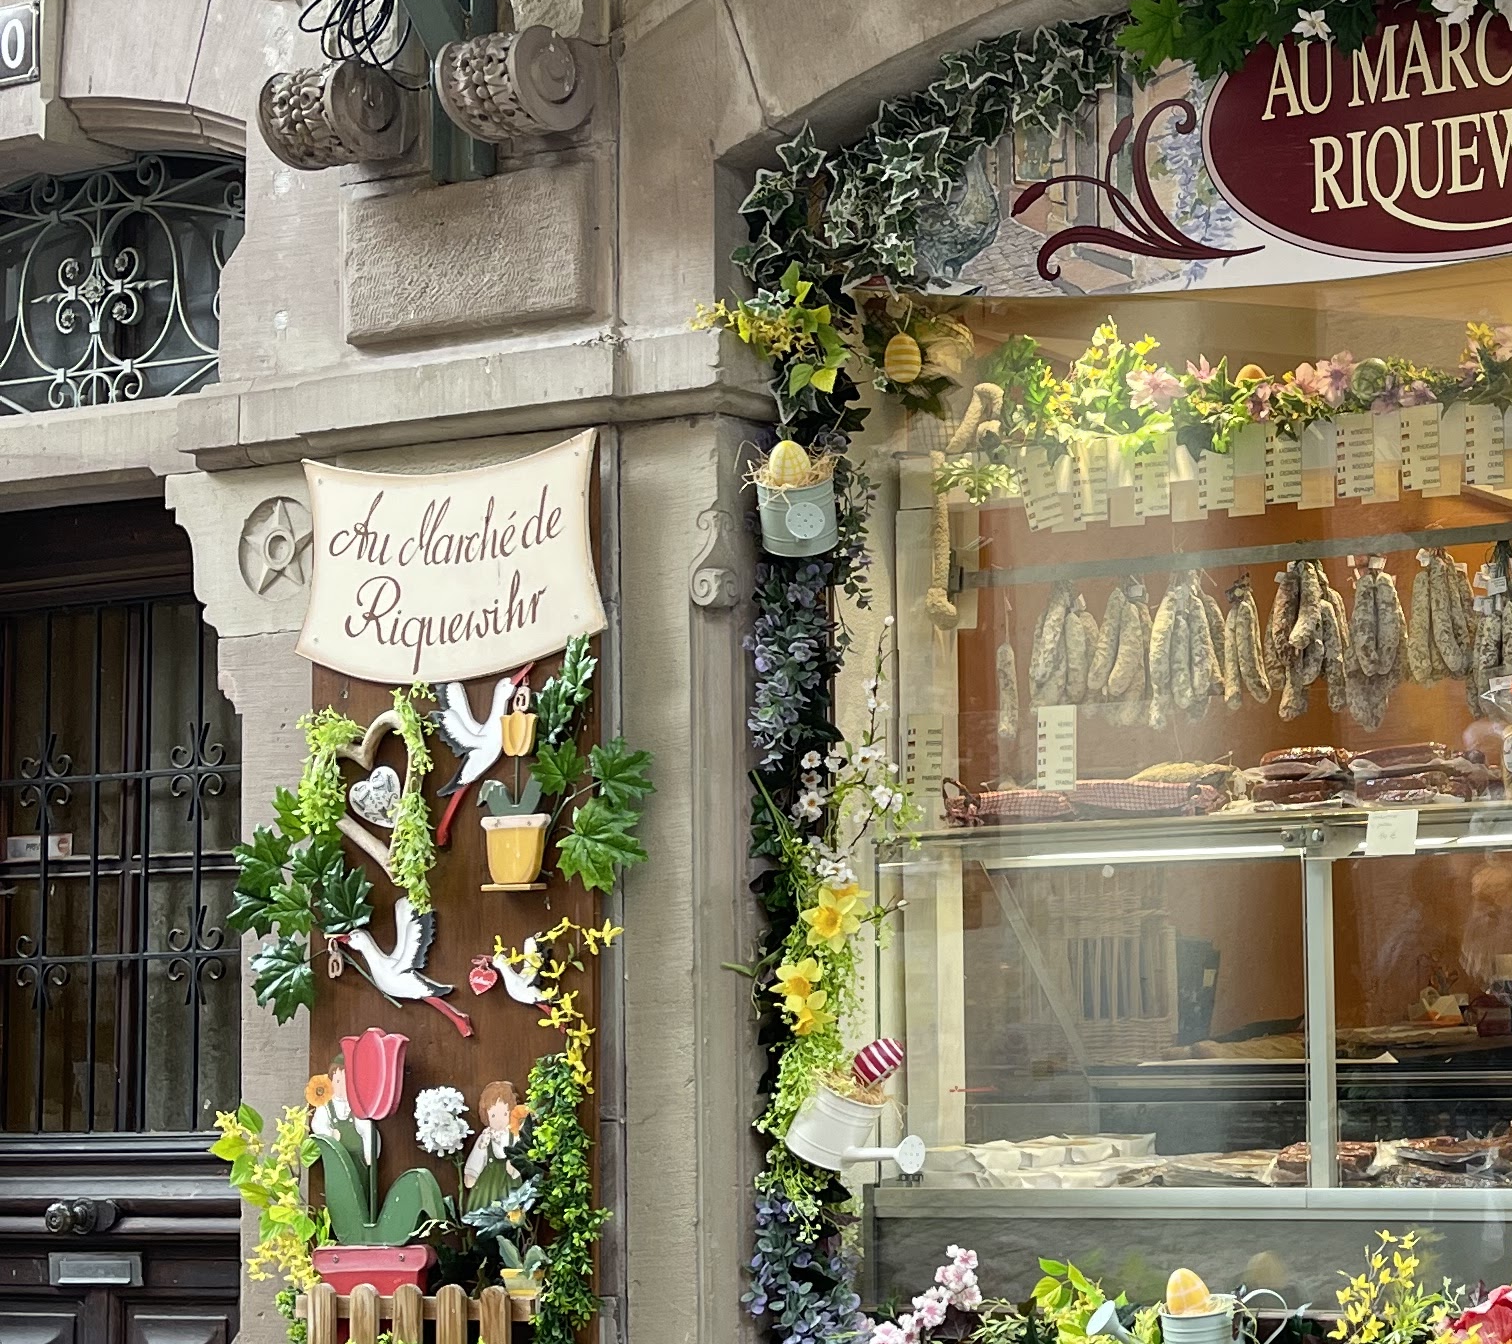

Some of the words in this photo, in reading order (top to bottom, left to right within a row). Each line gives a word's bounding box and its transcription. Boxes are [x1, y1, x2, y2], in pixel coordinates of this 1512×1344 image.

[1261, 37, 1334, 121] AU
[329, 490, 393, 566] Au
[398, 495, 518, 567] Marché
[521, 484, 565, 549] de
[344, 569, 548, 676] Riquewihr
